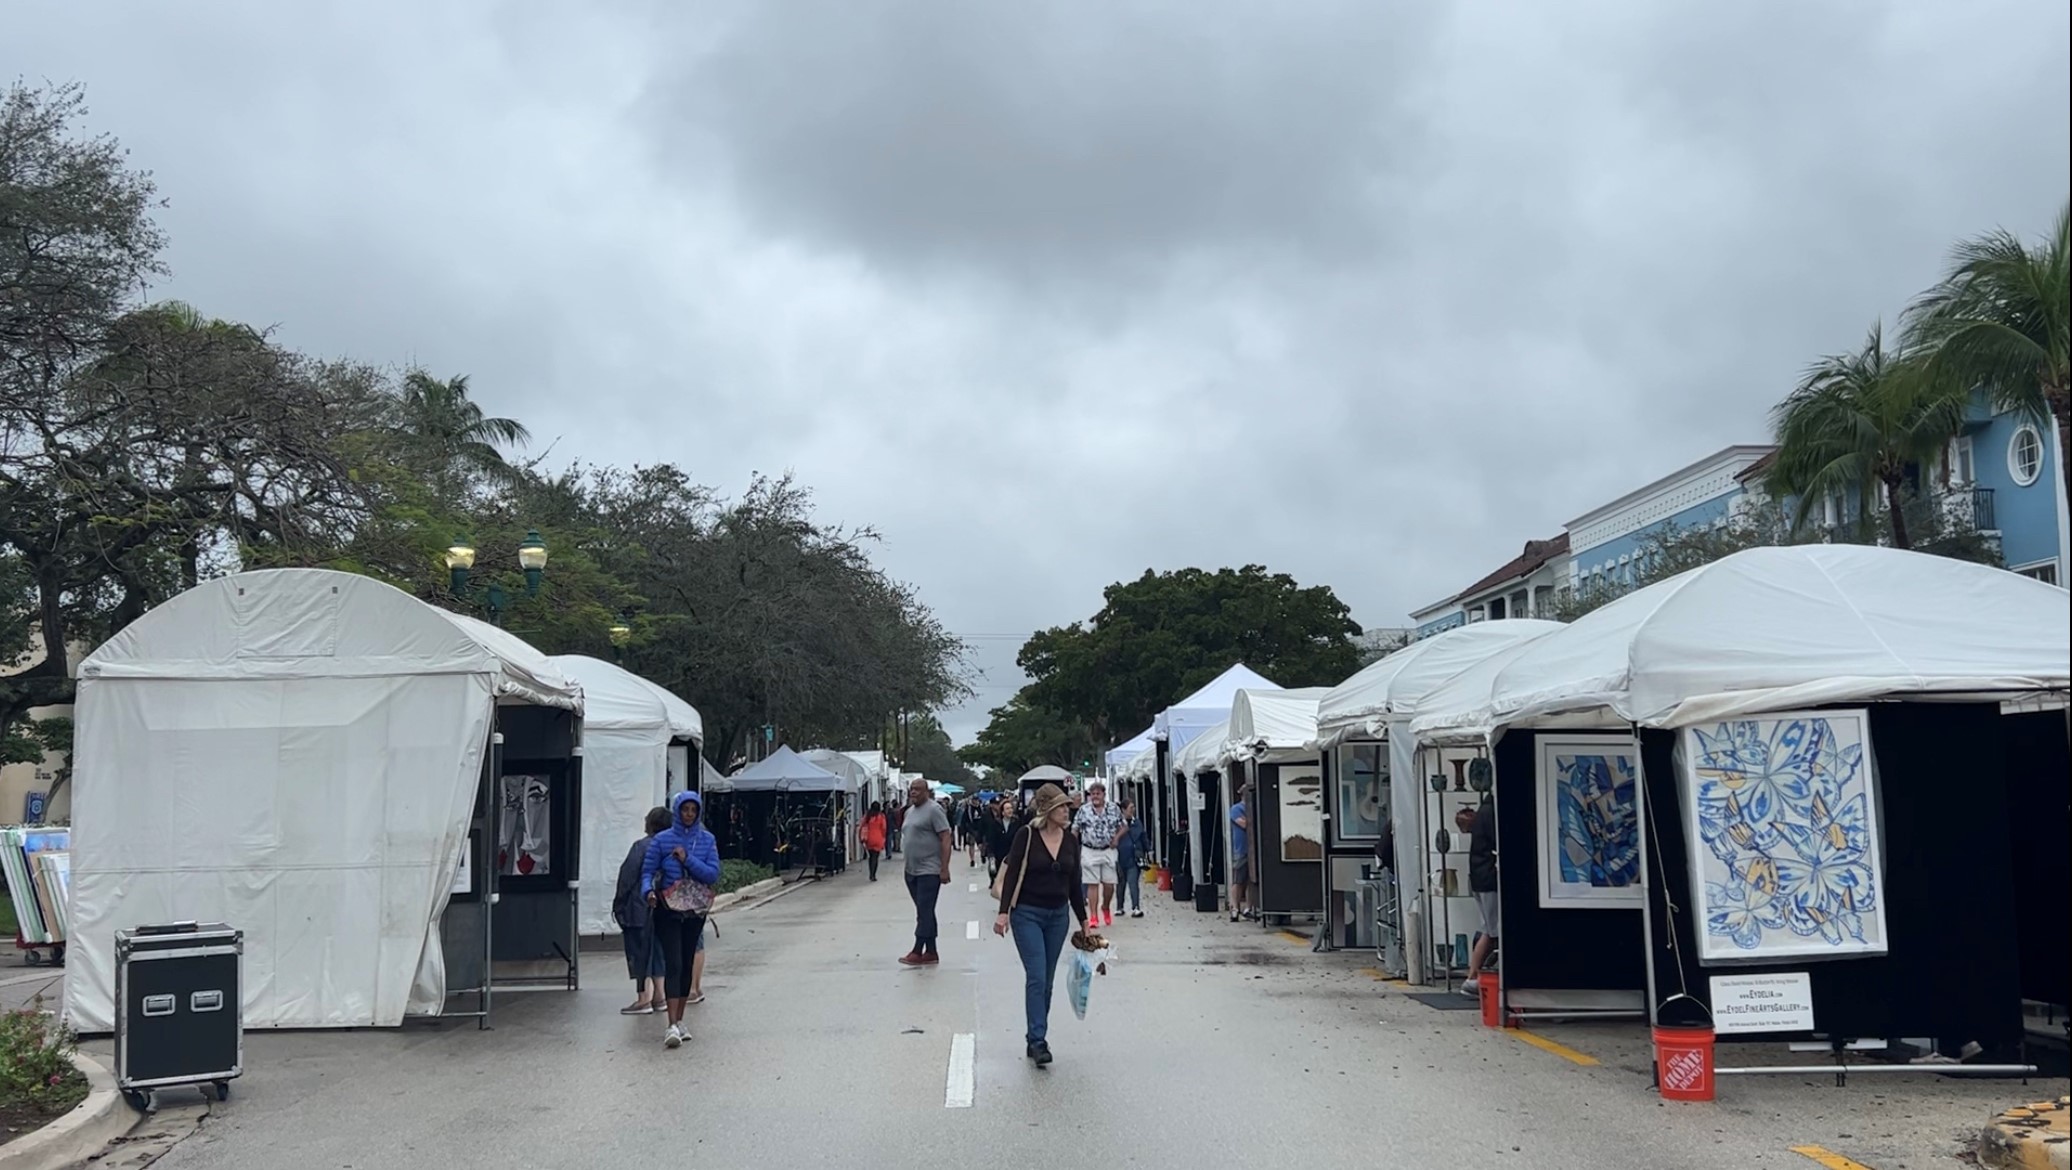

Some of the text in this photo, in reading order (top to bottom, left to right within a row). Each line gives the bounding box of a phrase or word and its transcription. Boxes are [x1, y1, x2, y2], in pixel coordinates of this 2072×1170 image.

[1664, 1050, 1702, 1089] HOME
[1666, 1053, 1683, 1069] THE
[1679, 1065, 1703, 1090] DEPOT
